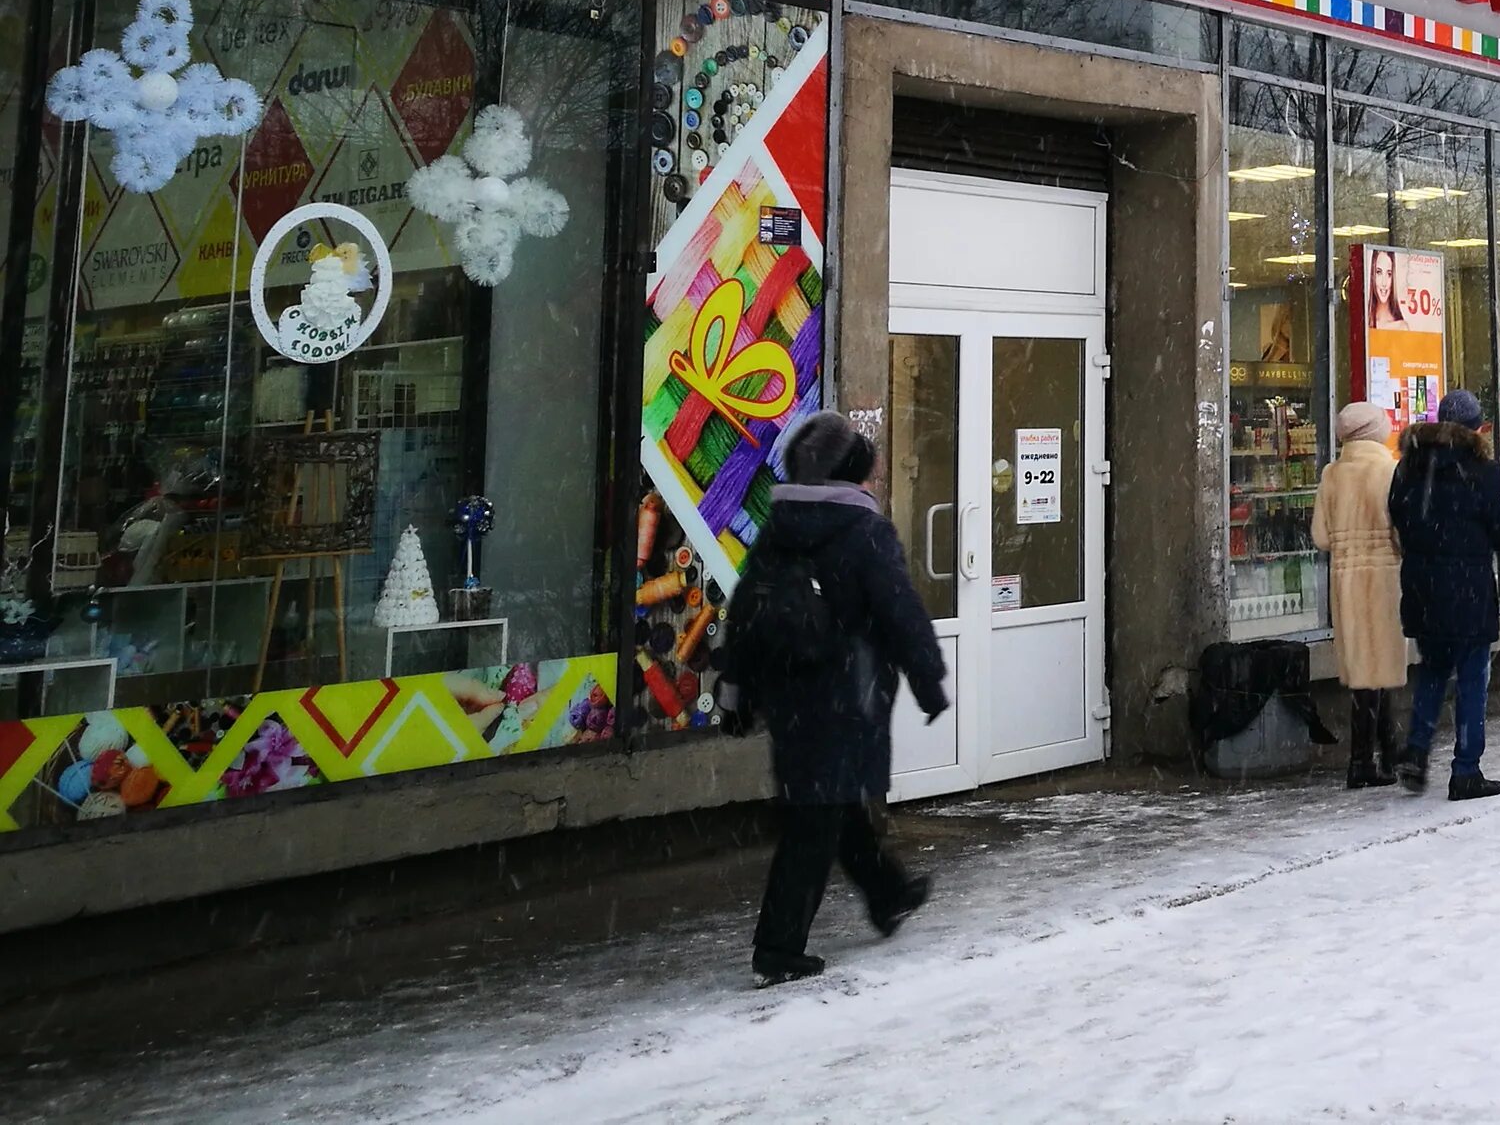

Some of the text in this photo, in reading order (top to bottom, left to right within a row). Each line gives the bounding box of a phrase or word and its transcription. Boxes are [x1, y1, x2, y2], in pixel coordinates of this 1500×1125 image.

[406, 75, 473, 100] БУЛАВКИ
[93, 242, 168, 272] SWAROVSKI
[198, 241, 239, 261] КАНВ
[1400, 288, 1441, 316] -30%
[1021, 453, 1058, 462] ежедневно
[1024, 470, 1055, 485] 9-22
